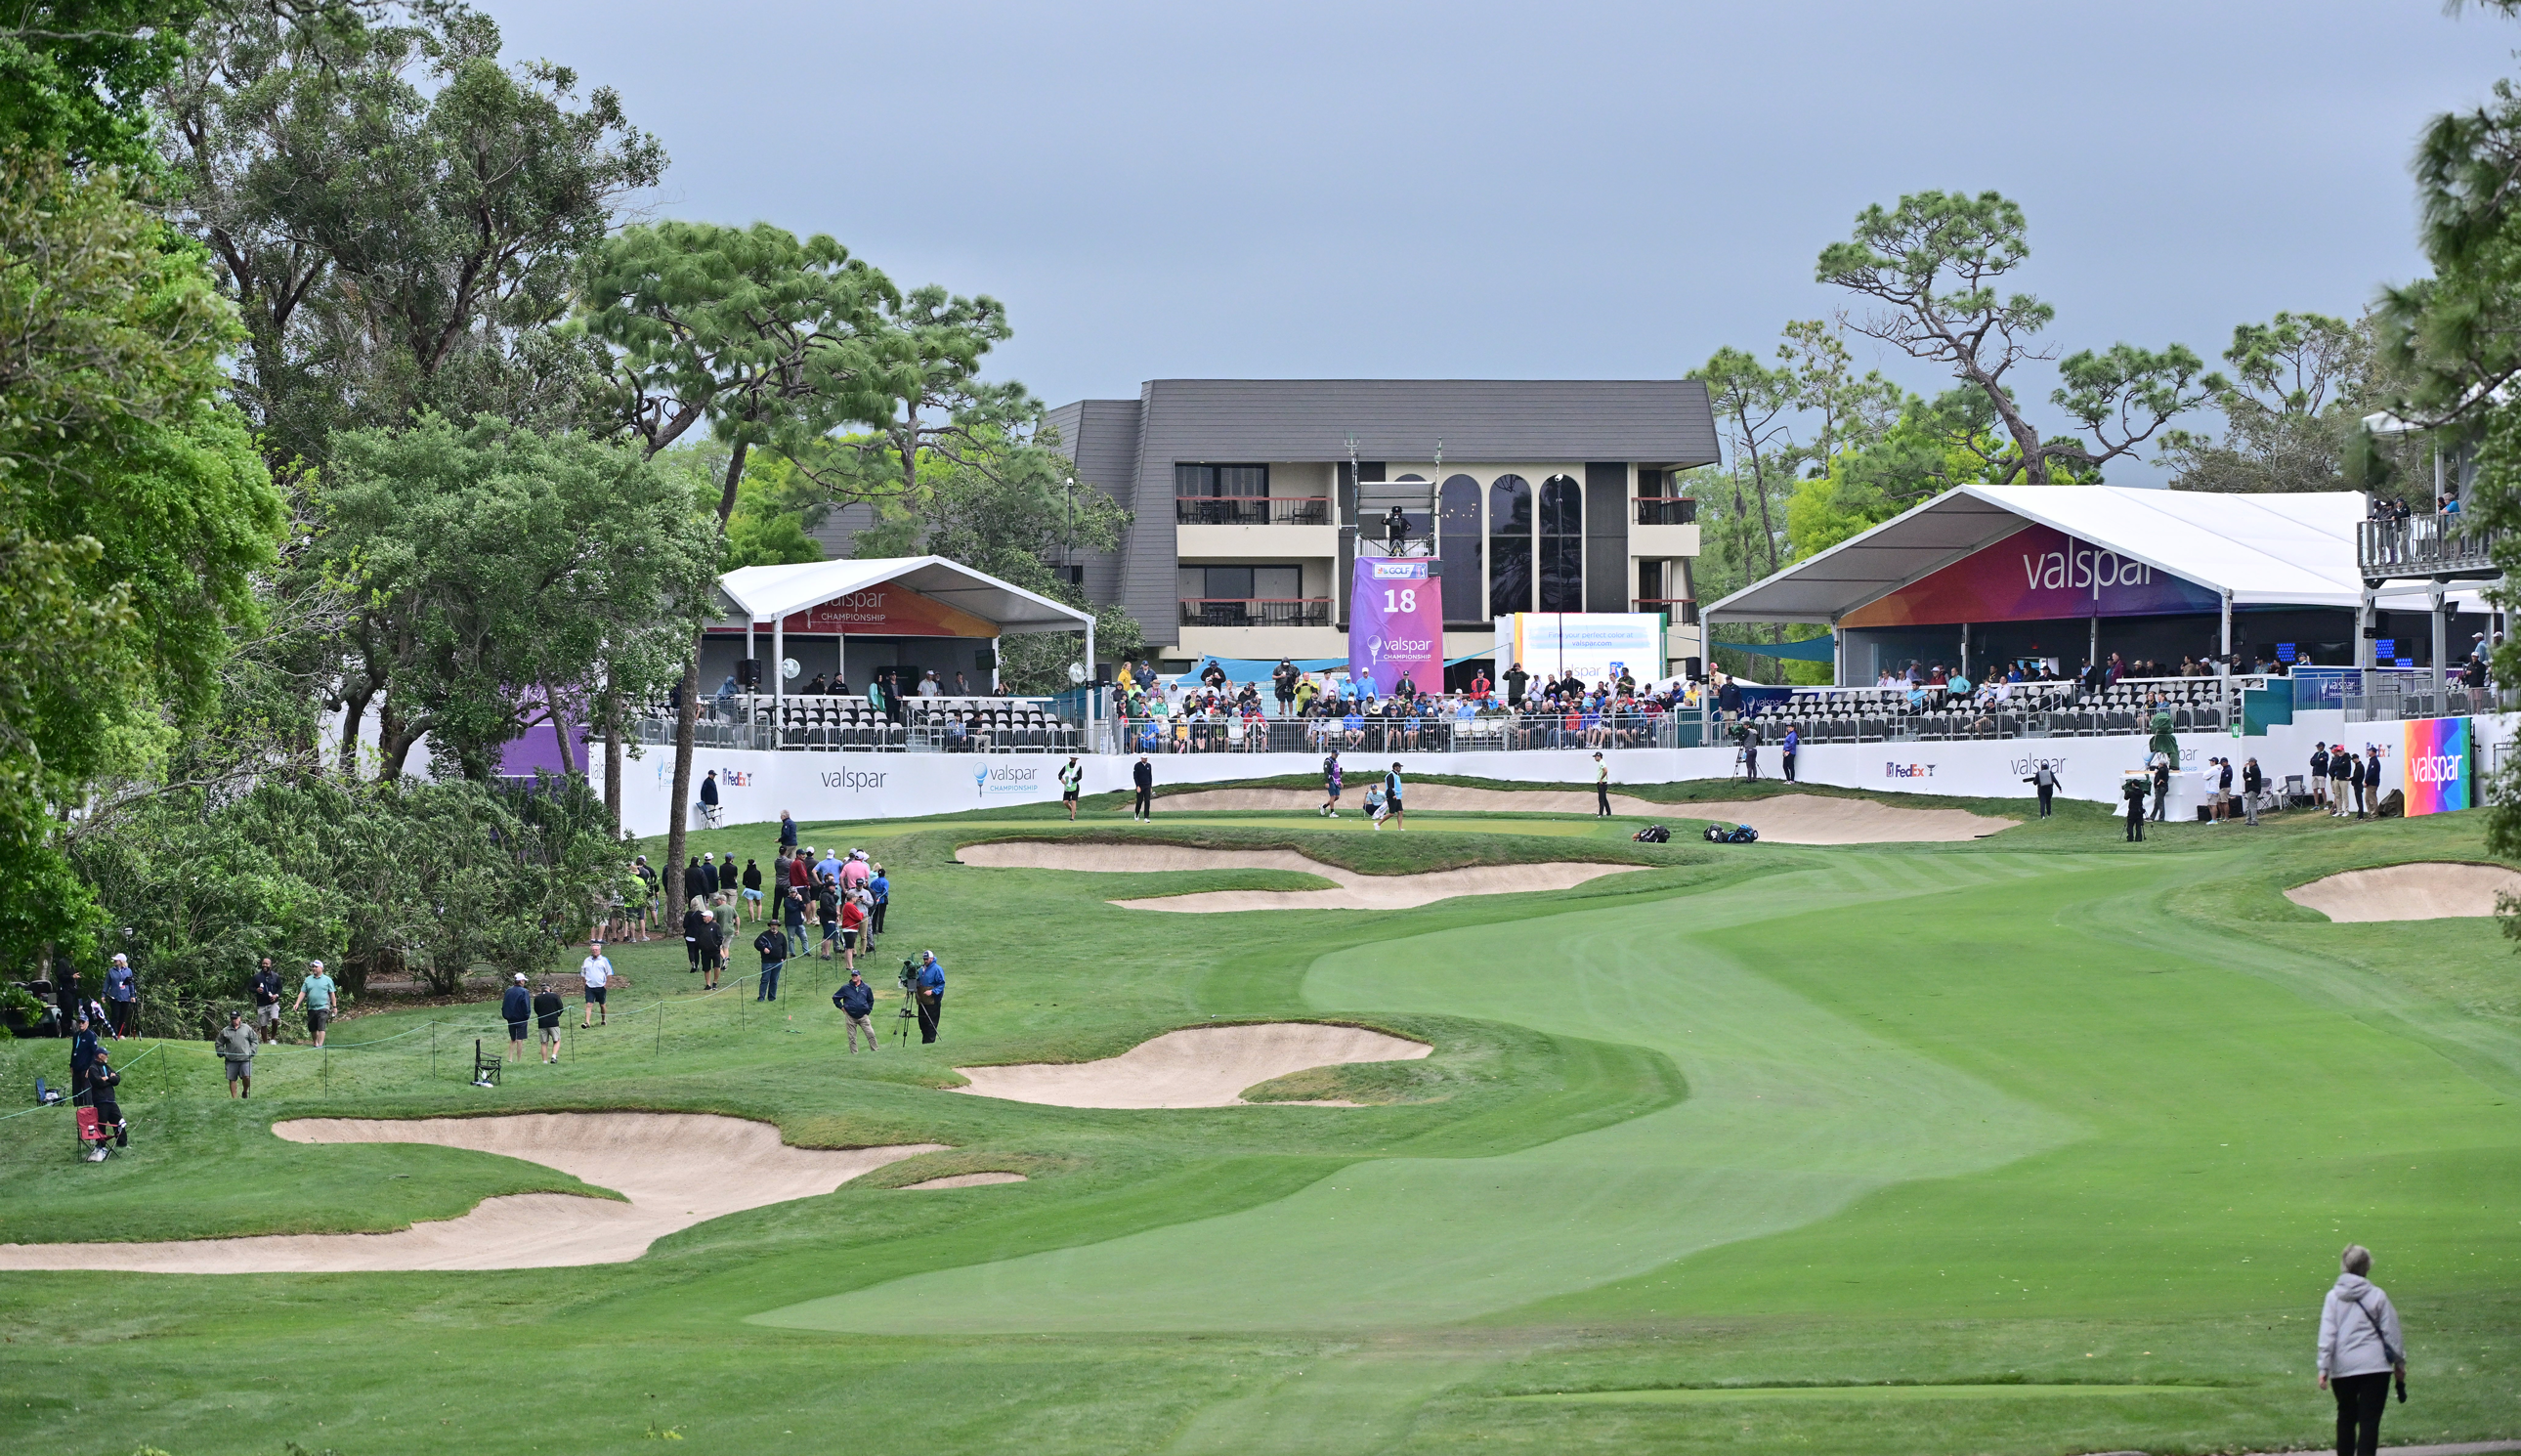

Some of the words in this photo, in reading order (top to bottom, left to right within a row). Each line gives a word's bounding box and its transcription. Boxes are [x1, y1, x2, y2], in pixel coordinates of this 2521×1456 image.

[1384, 588, 1417, 614] 18
[821, 613, 886, 621] CHAMPIONSHIP
[1582, 630, 1606, 639] perfect
[1384, 636, 1431, 654] valspar
[590, 756, 605, 780] vals
[990, 764, 1038, 784] valspar
[1895, 763, 1924, 778] FedEx
[2412, 746, 2462, 791] valspar
[728, 770, 747, 787] FedEx
[821, 765, 887, 792] valspar
